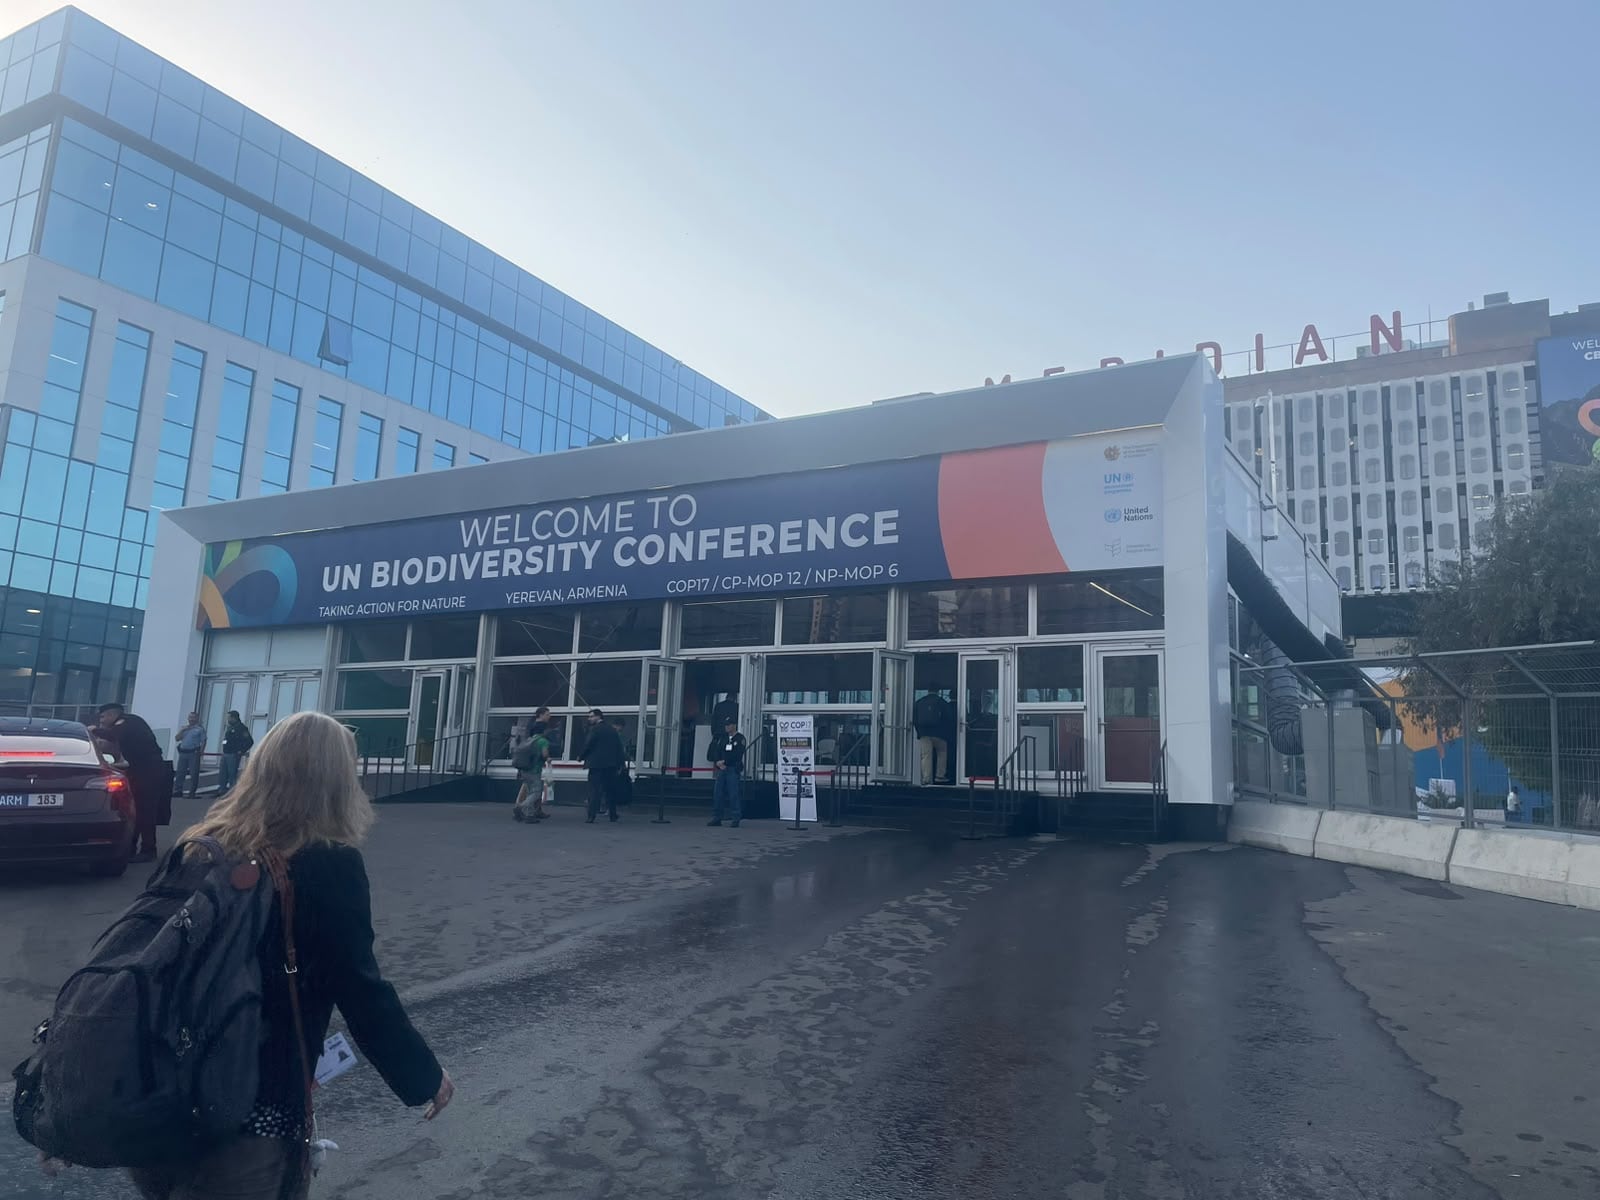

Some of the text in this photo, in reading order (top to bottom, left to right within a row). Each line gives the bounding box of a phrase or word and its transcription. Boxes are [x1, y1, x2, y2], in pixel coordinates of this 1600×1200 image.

[984, 311, 1401, 387] DIAN
[1104, 473, 1121, 484] UN
[1124, 506, 1149, 515] United
[1124, 513, 1153, 522] Nations
[460, 494, 697, 548] WELCOME TO
[322, 509, 899, 592] UN BIODIVERSITY CONFERENCE
[667, 563, 899, 593] COP17 / CP-MOP 12 / NP-MOP 6
[506, 584, 628, 604] YEREVAN, ARMENIA
[319, 596, 466, 617] TAKING ACTION FOR NATURE
[37, 795, 57, 805] 183
